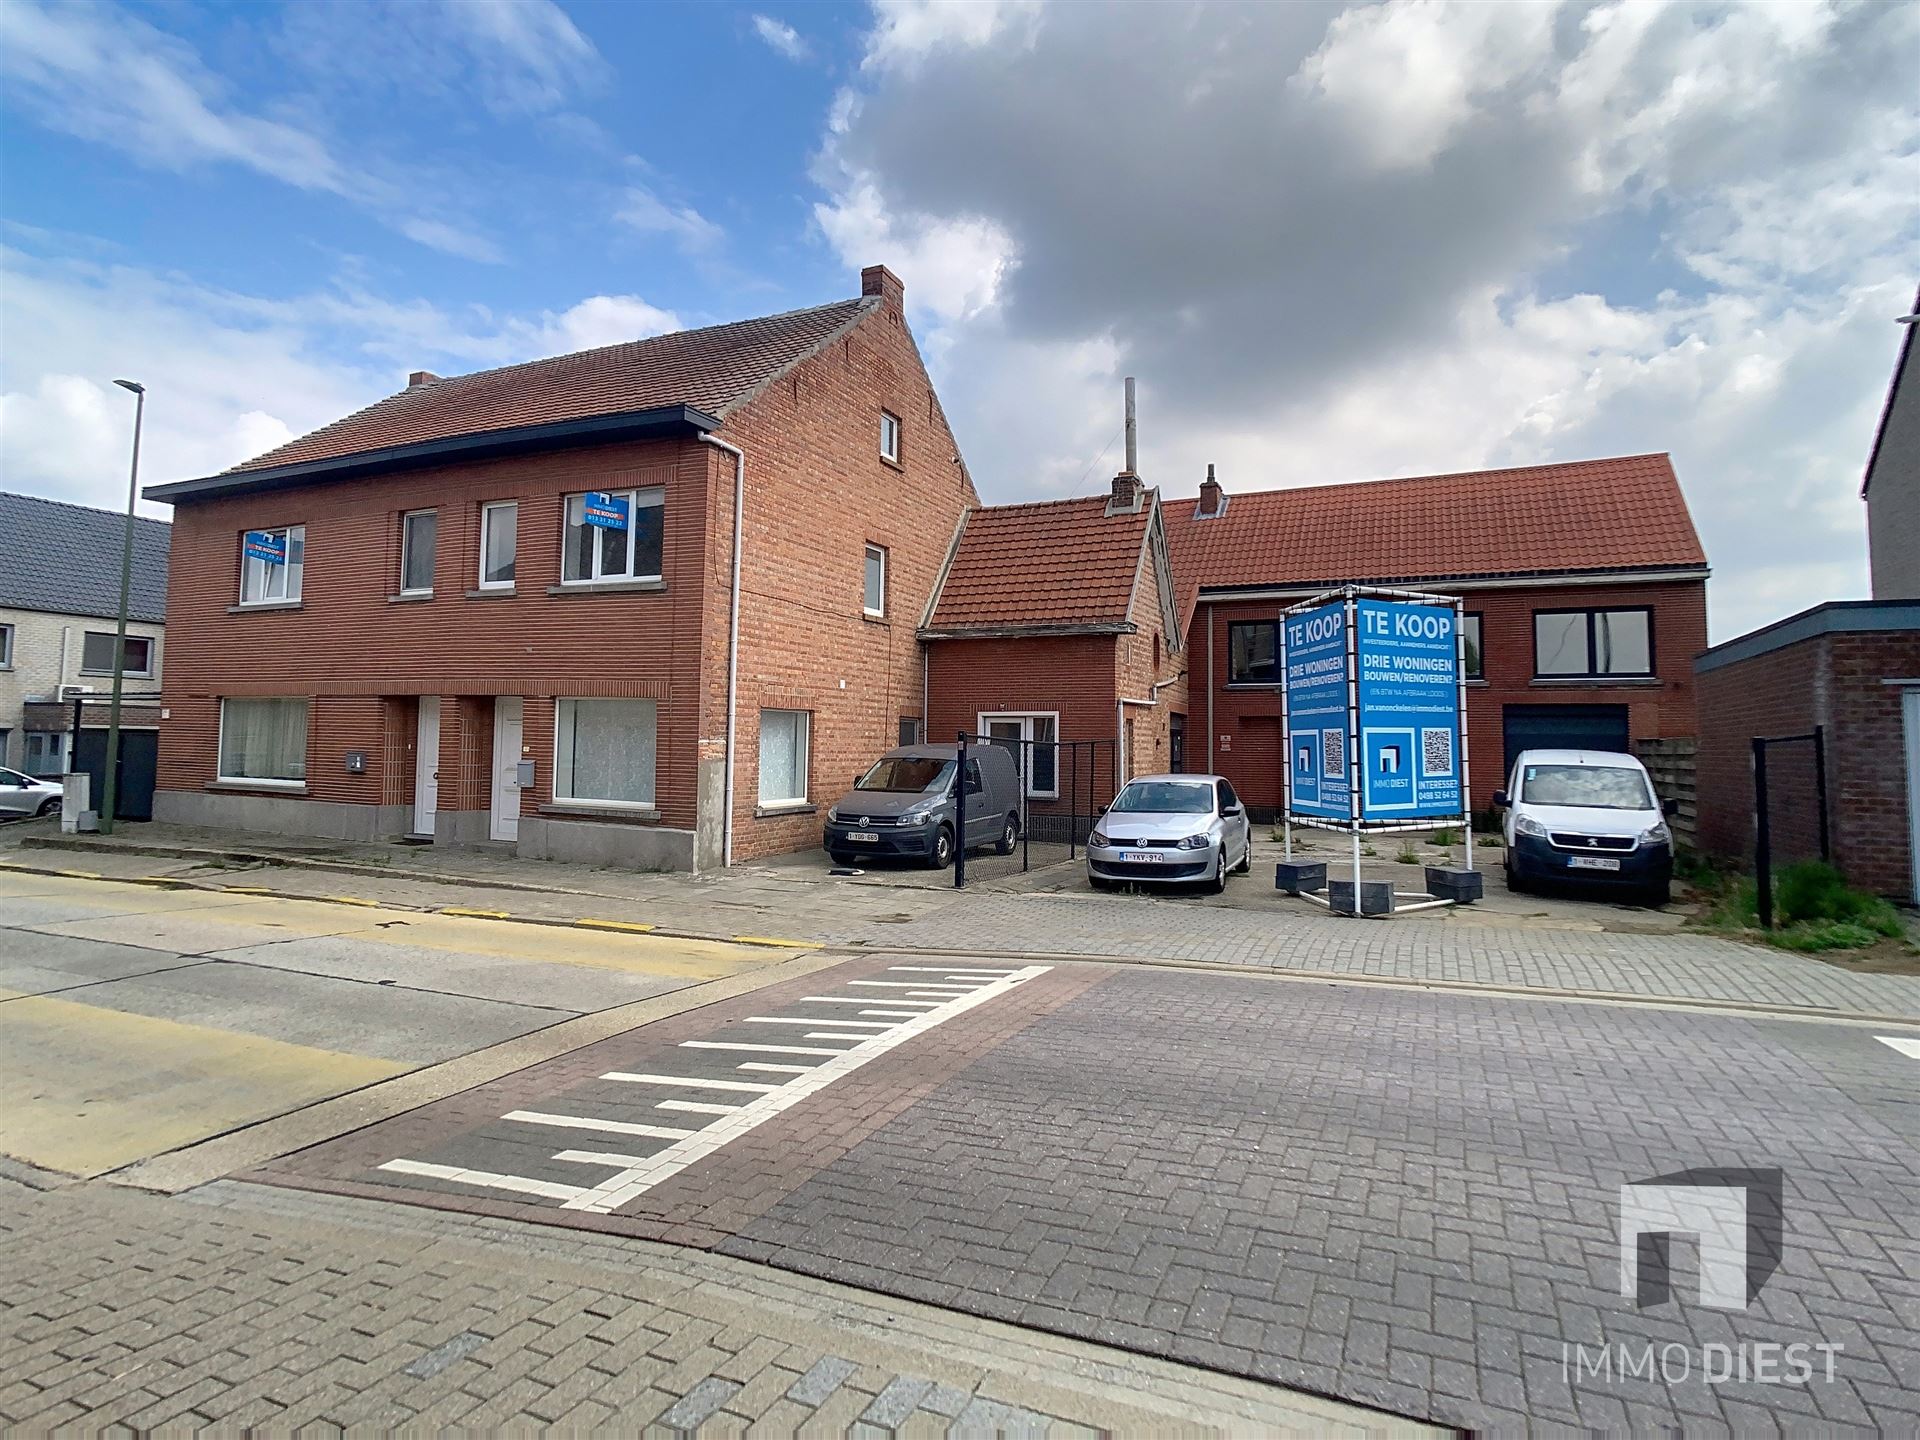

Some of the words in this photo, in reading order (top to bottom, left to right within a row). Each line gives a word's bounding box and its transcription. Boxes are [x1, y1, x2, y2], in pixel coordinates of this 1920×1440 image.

[600, 510, 619, 518] KOOP
[262, 546, 280, 555] KOOP
[1289, 624, 1303, 647] TE
[1306, 613, 1342, 644] KOOP
[1363, 610, 1389, 635] TE
[1396, 613, 1450, 640] KOOP
[1289, 663, 1304, 678] DRIE
[1305, 655, 1343, 675] WONINGEN
[1363, 653, 1391, 669] DRIE
[1392, 655, 1453, 672] WONINGEN
[1289, 672, 1344, 689] BOUWEN/RENOVEREN?
[1364, 670, 1453, 684] BOUWEN/RENOVEREN?
[1390, 778, 1409, 788] DIEST
[1418, 779, 1458, 790] INTERESSE?
